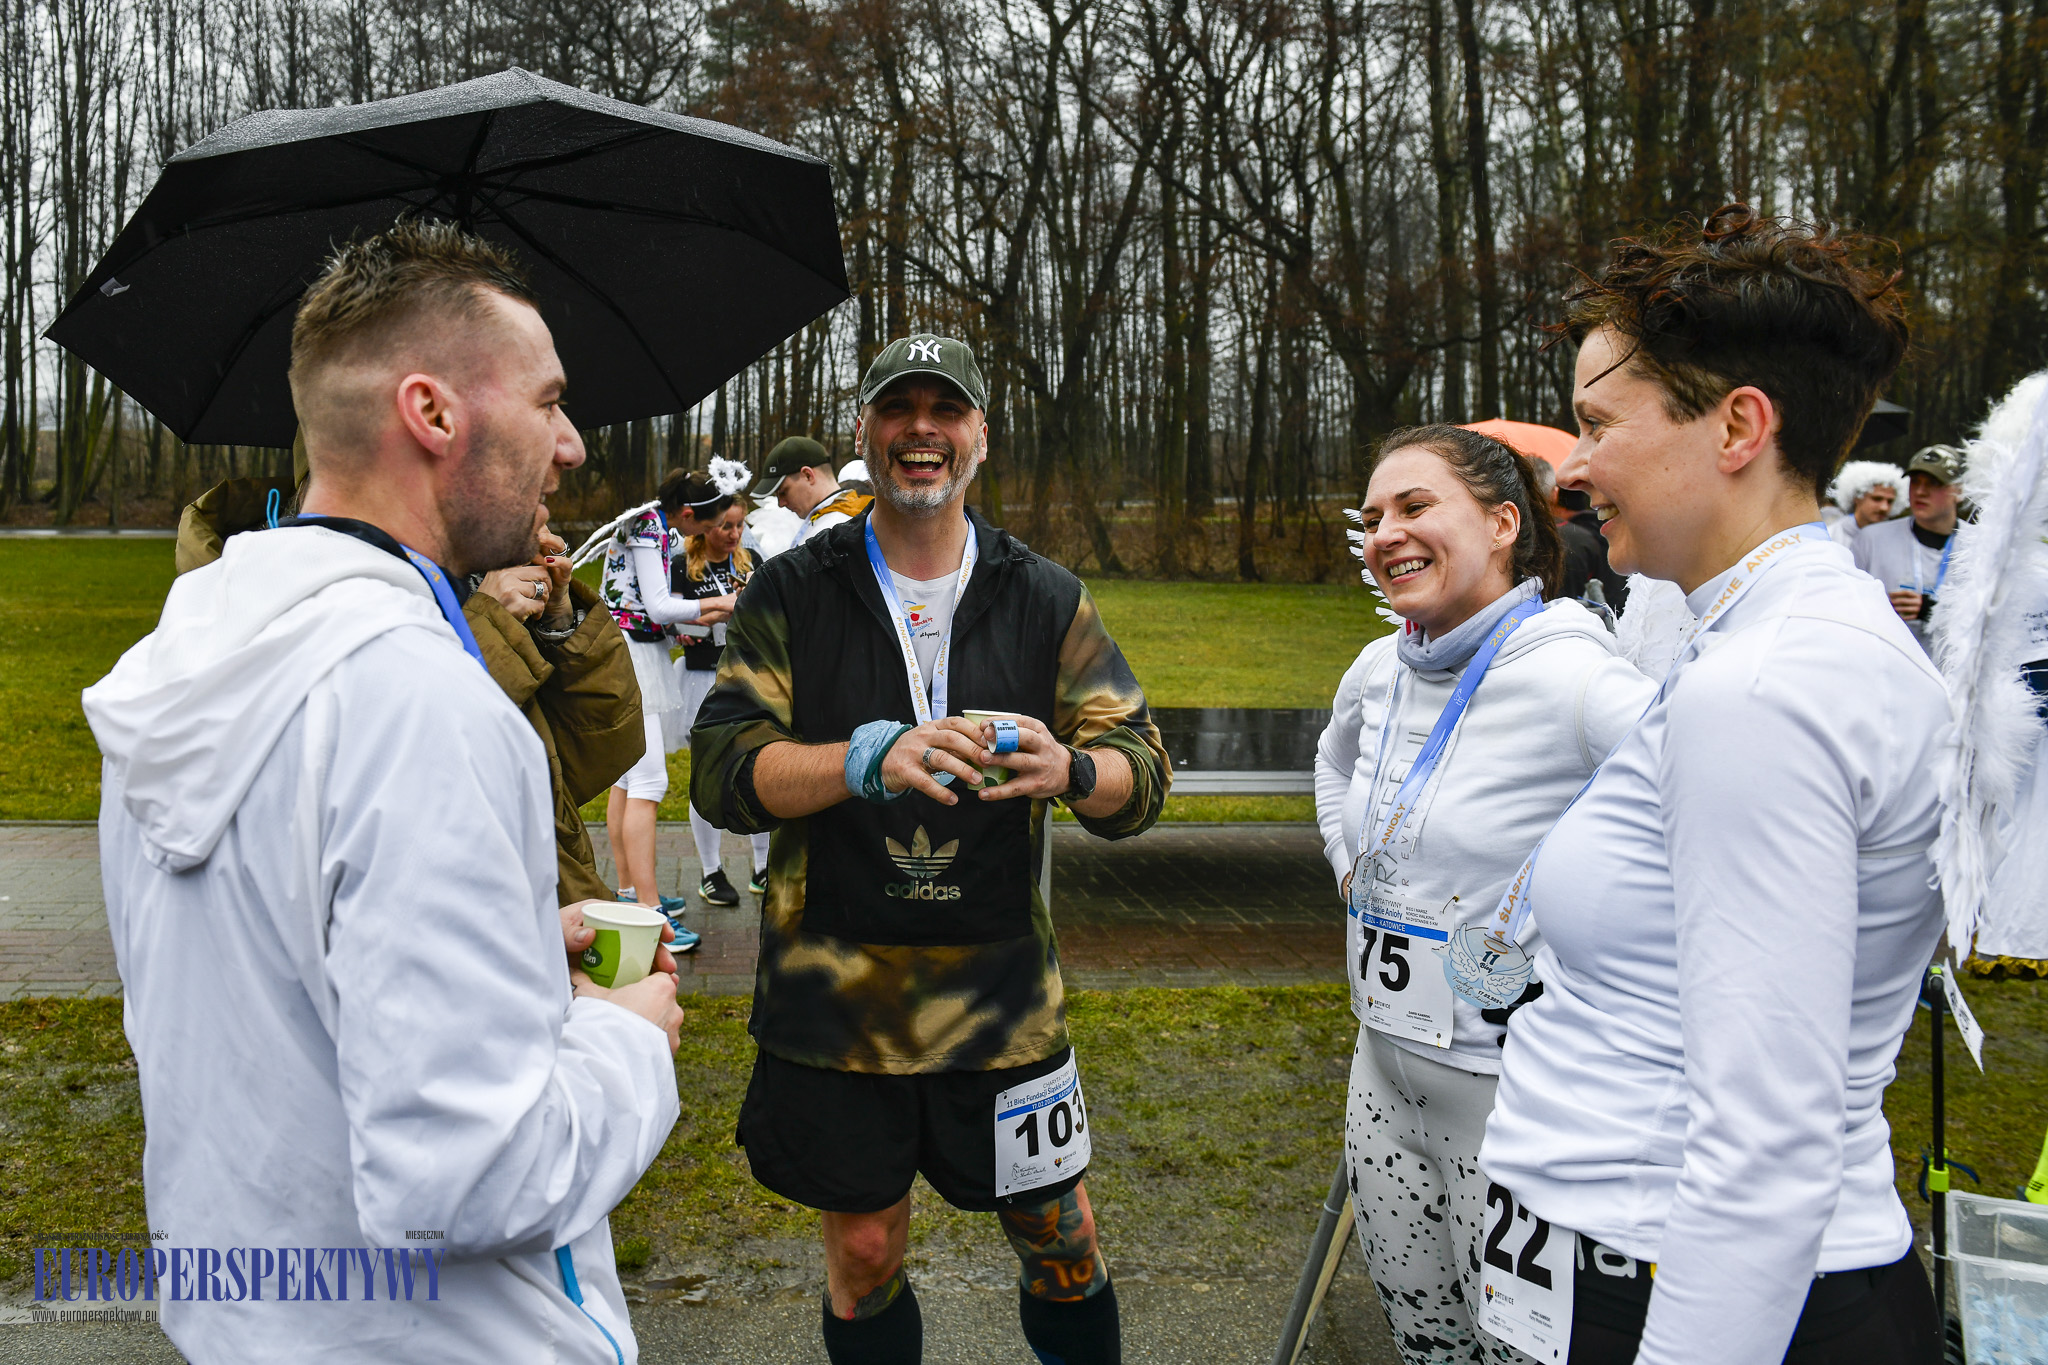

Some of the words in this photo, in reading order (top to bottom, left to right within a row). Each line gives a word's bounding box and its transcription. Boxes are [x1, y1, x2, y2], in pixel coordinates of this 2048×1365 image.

[907, 339, 943, 363] NY
[960, 554, 972, 585] ANIOŁY
[1746, 533, 1801, 573] ANIOŁY
[1490, 617, 1519, 647] 2024
[896, 617, 915, 668] FUNDACJA
[912, 672, 927, 715] ŚLĄSKIE
[937, 640, 948, 676] ANIOŁY
[1382, 803, 1406, 845] ANIOŁY
[884, 880, 962, 901] adidas
[1499, 860, 1533, 923] ŚLĄSKIE
[1380, 920, 1406, 932] KATOWICE
[1385, 907, 1403, 920] Anioły
[1361, 927, 1410, 991] 75
[1482, 951, 1500, 965] 11
[1014, 1098, 1026, 1107] Bieg
[1026, 1089, 1047, 1103] Fundacji
[1015, 1087, 1084, 1157] 103
[1484, 1181, 1552, 1291] 22
